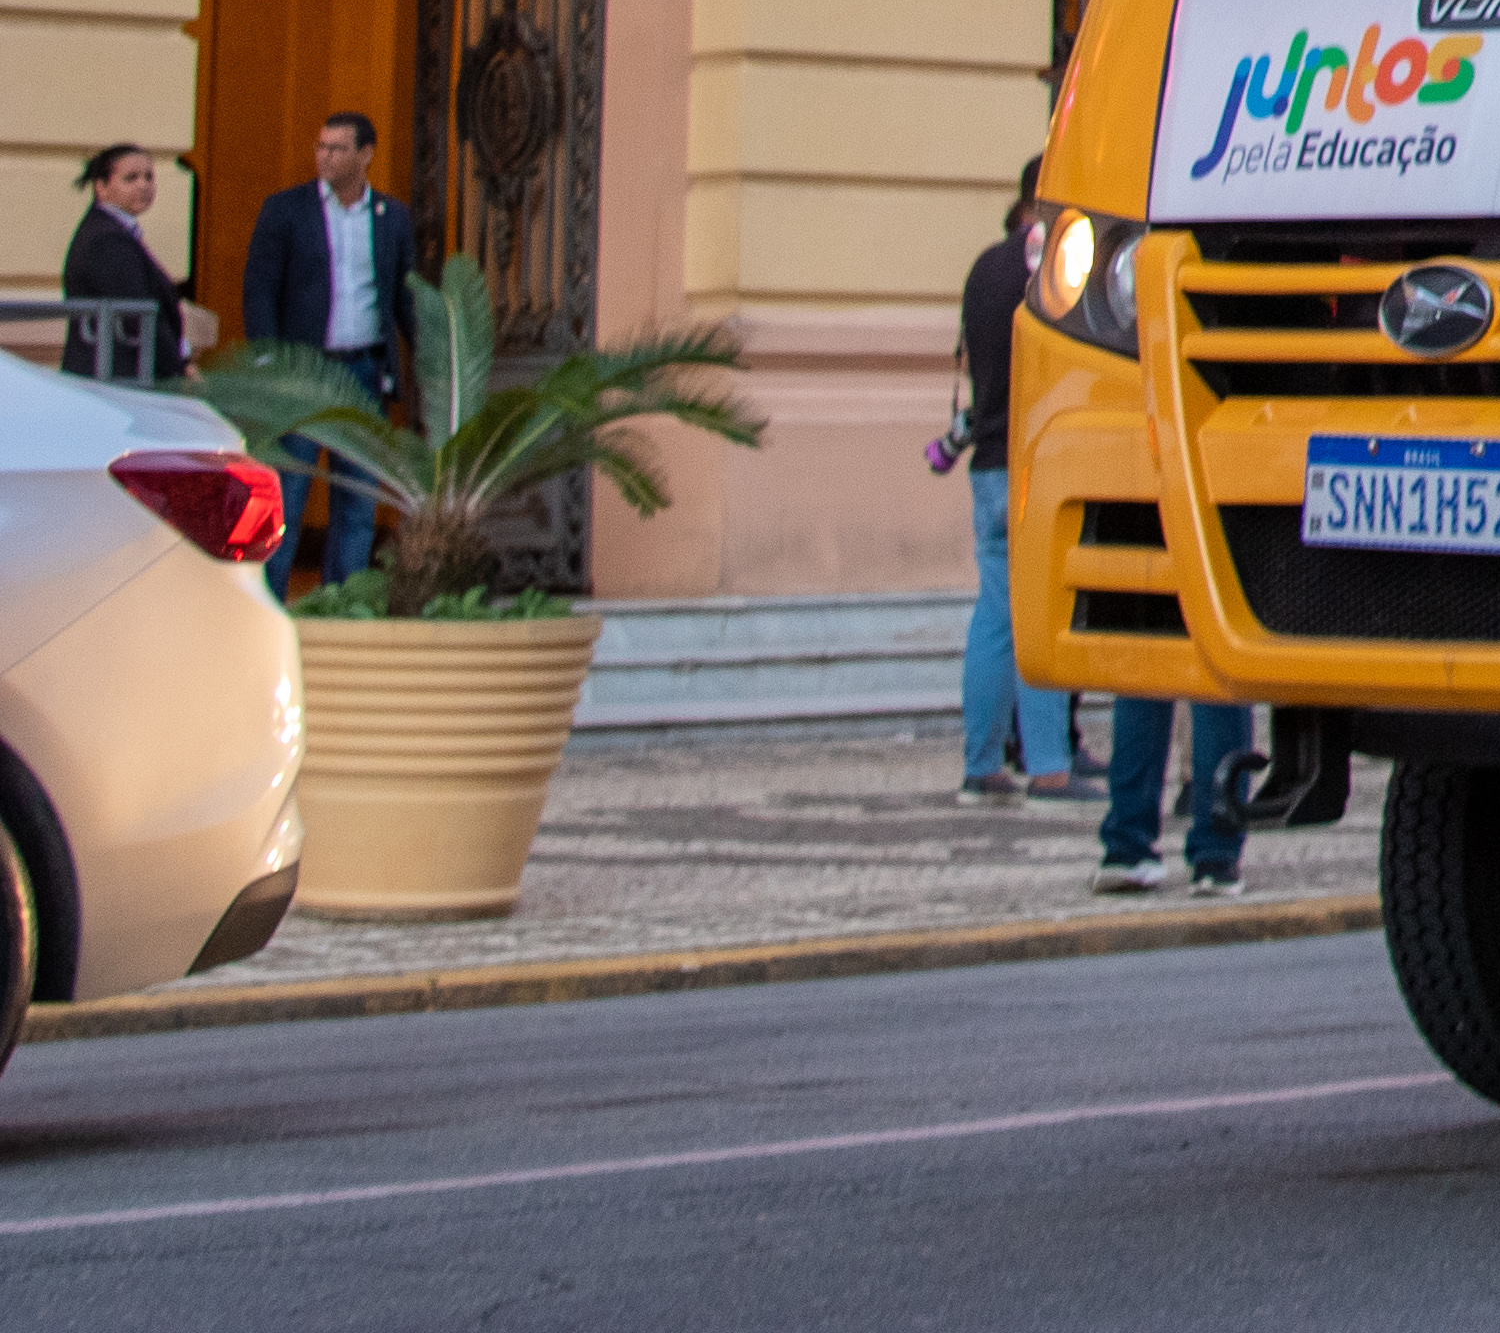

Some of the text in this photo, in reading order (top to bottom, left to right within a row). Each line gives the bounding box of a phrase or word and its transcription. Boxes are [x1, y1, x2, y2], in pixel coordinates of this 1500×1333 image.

[1191, 24, 1484, 181] juntos
[1223, 124, 1459, 183] pela Educação
